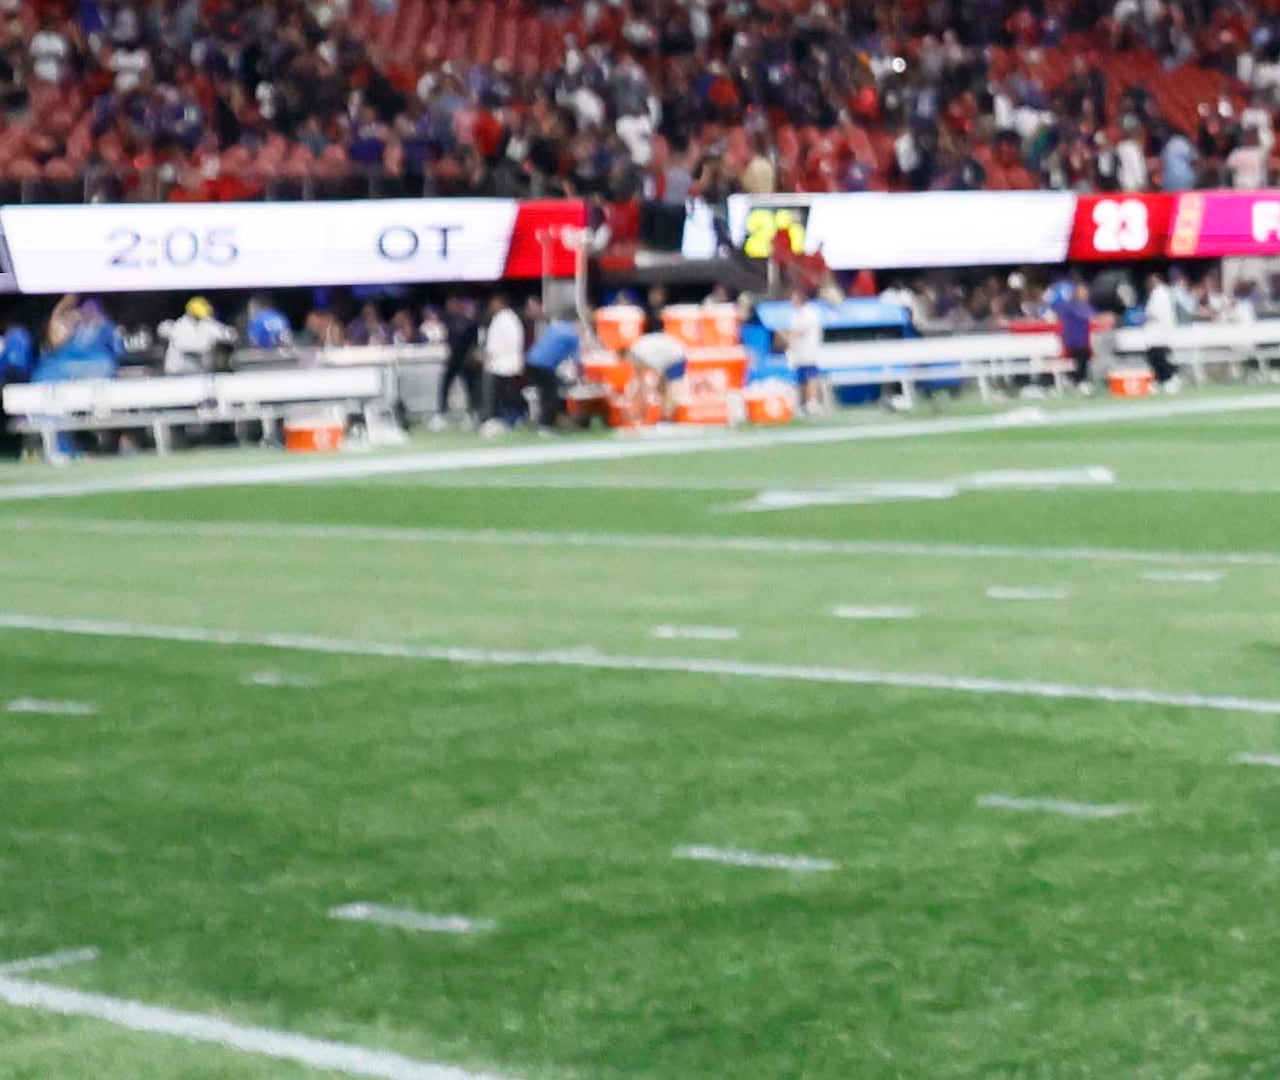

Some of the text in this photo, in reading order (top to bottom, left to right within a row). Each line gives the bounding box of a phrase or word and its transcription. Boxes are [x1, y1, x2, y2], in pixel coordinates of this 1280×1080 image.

[105, 226, 239, 268] 2:05
[376, 224, 463, 261] OT
[1092, 201, 1150, 253] 23
